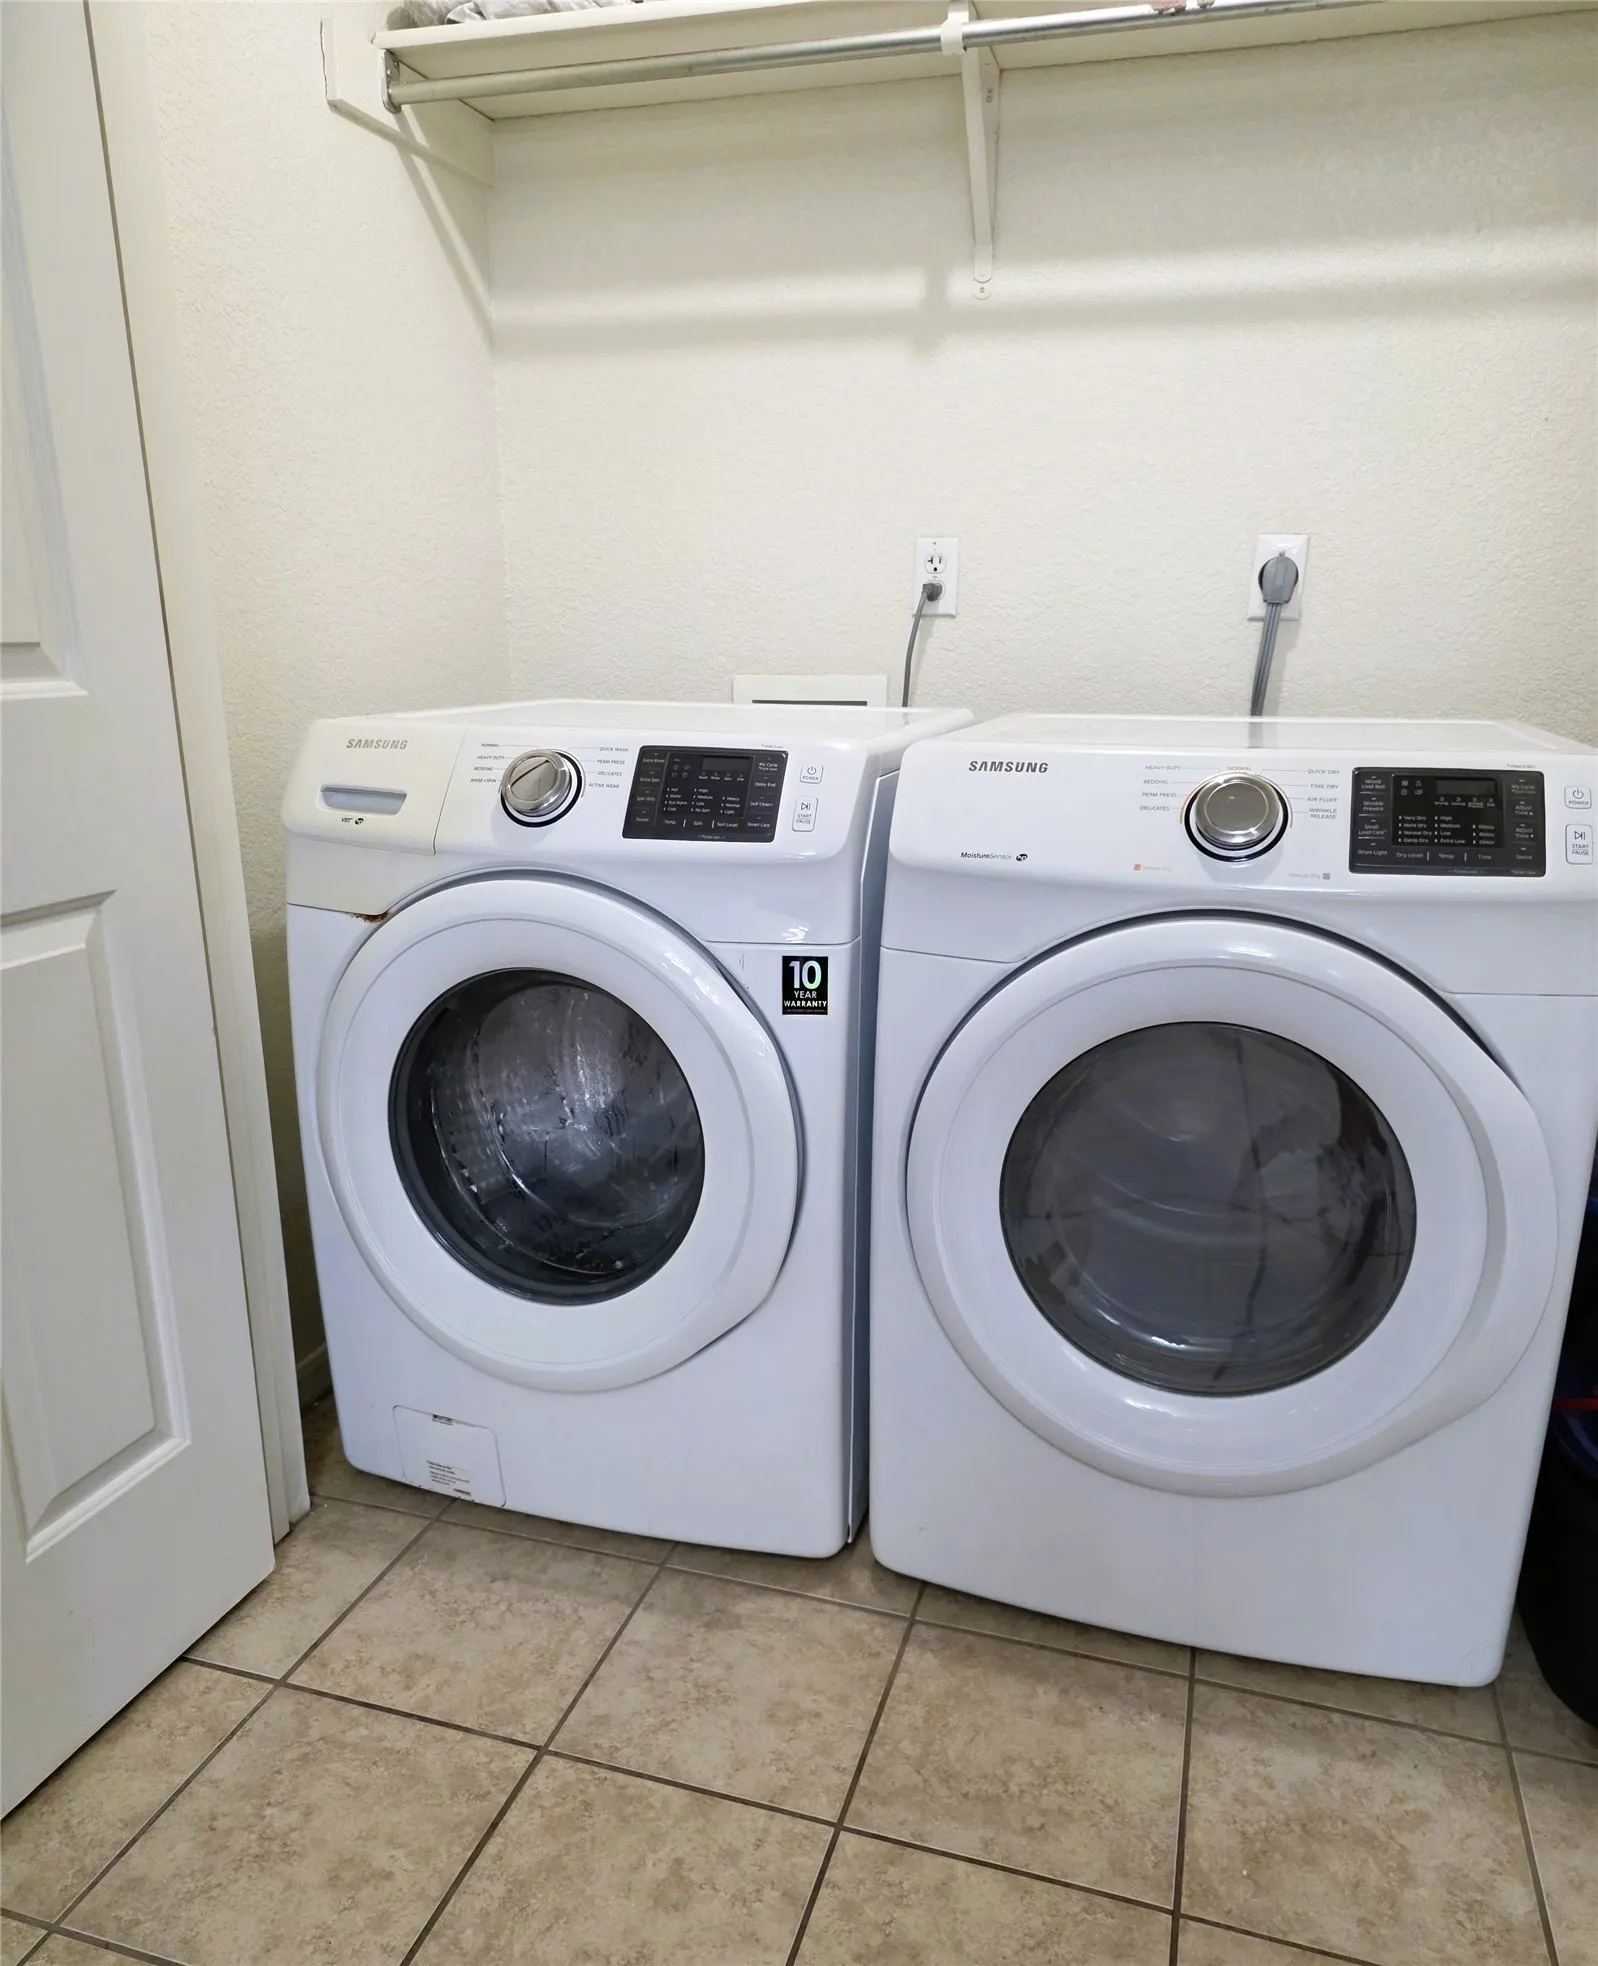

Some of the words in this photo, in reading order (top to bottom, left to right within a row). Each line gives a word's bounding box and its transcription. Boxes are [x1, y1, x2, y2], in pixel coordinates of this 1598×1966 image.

[347, 739, 408, 749] SAMSUNG
[969, 761, 1048, 773] SAMSUNG
[789, 960, 821, 989] 10
